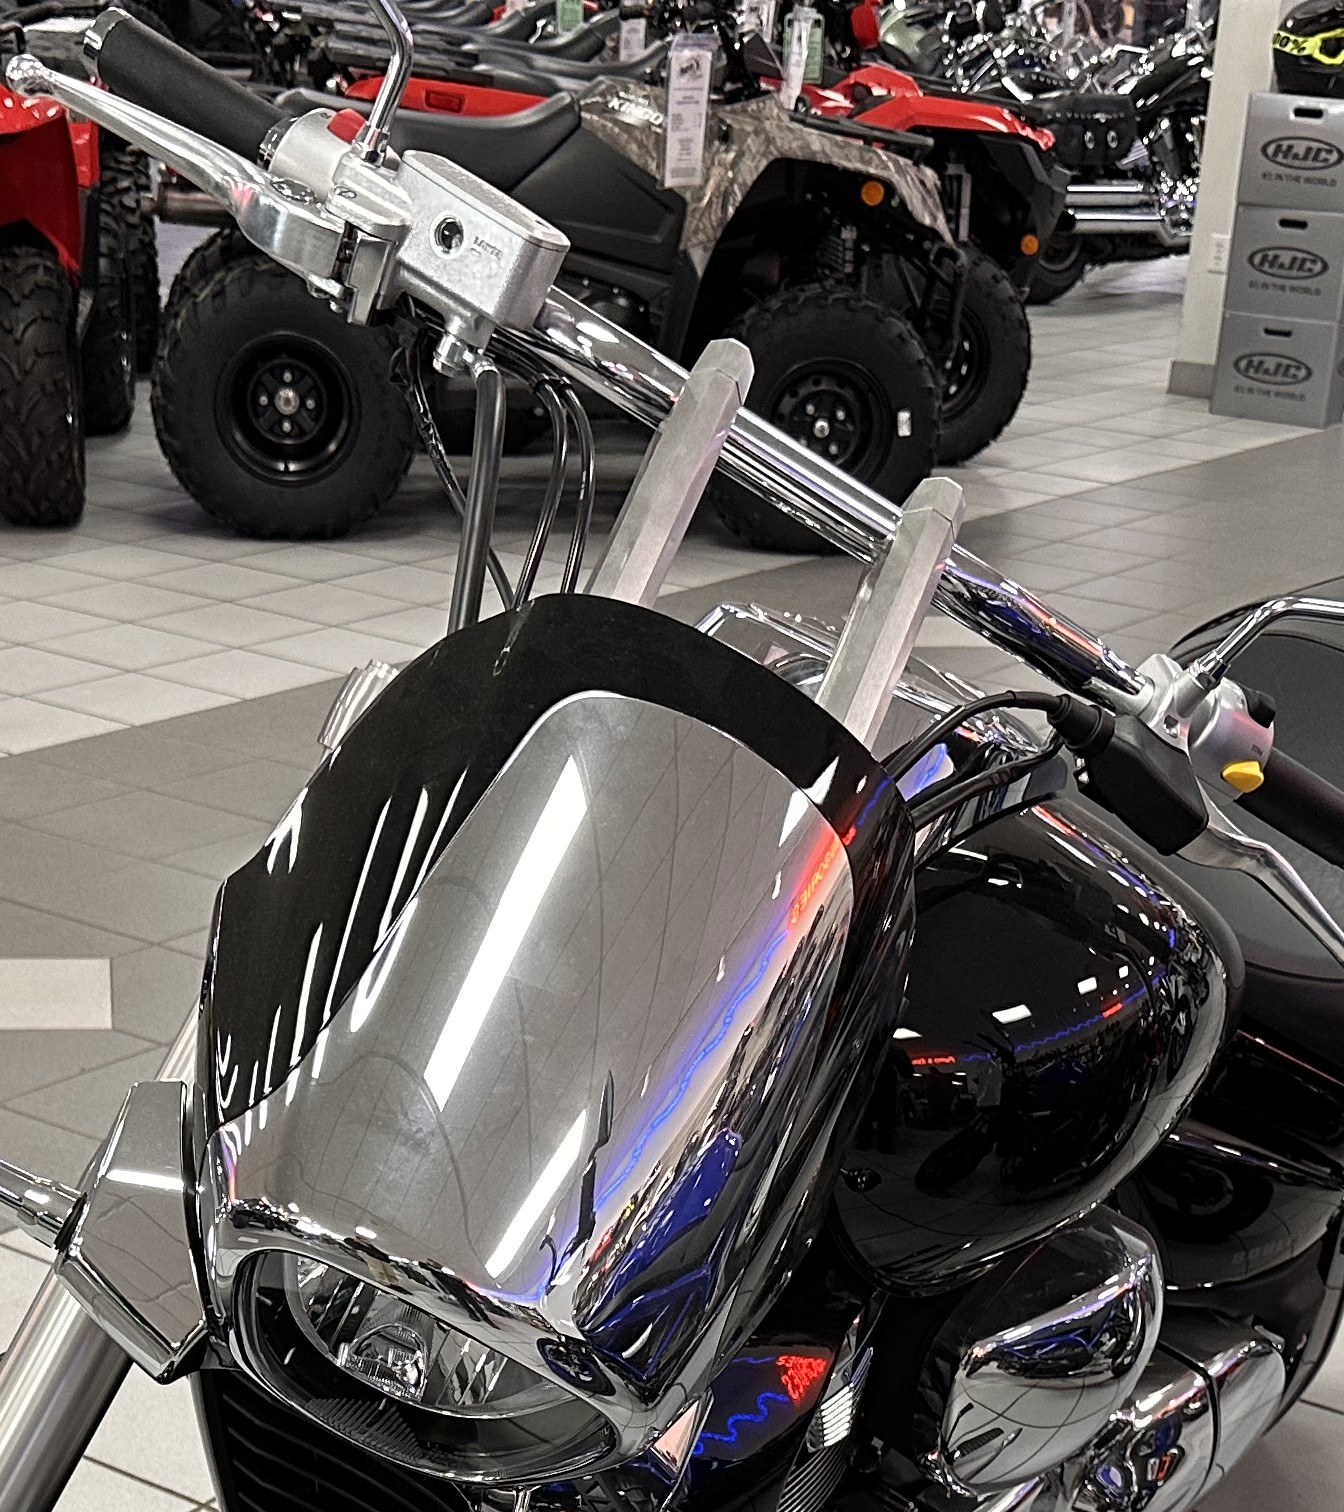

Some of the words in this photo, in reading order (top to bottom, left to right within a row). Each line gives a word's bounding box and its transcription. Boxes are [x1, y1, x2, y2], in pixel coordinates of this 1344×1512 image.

[1271, 143, 1334, 163] HJC
[1258, 253, 1318, 272] HJC
[1244, 359, 1304, 380] HJC
